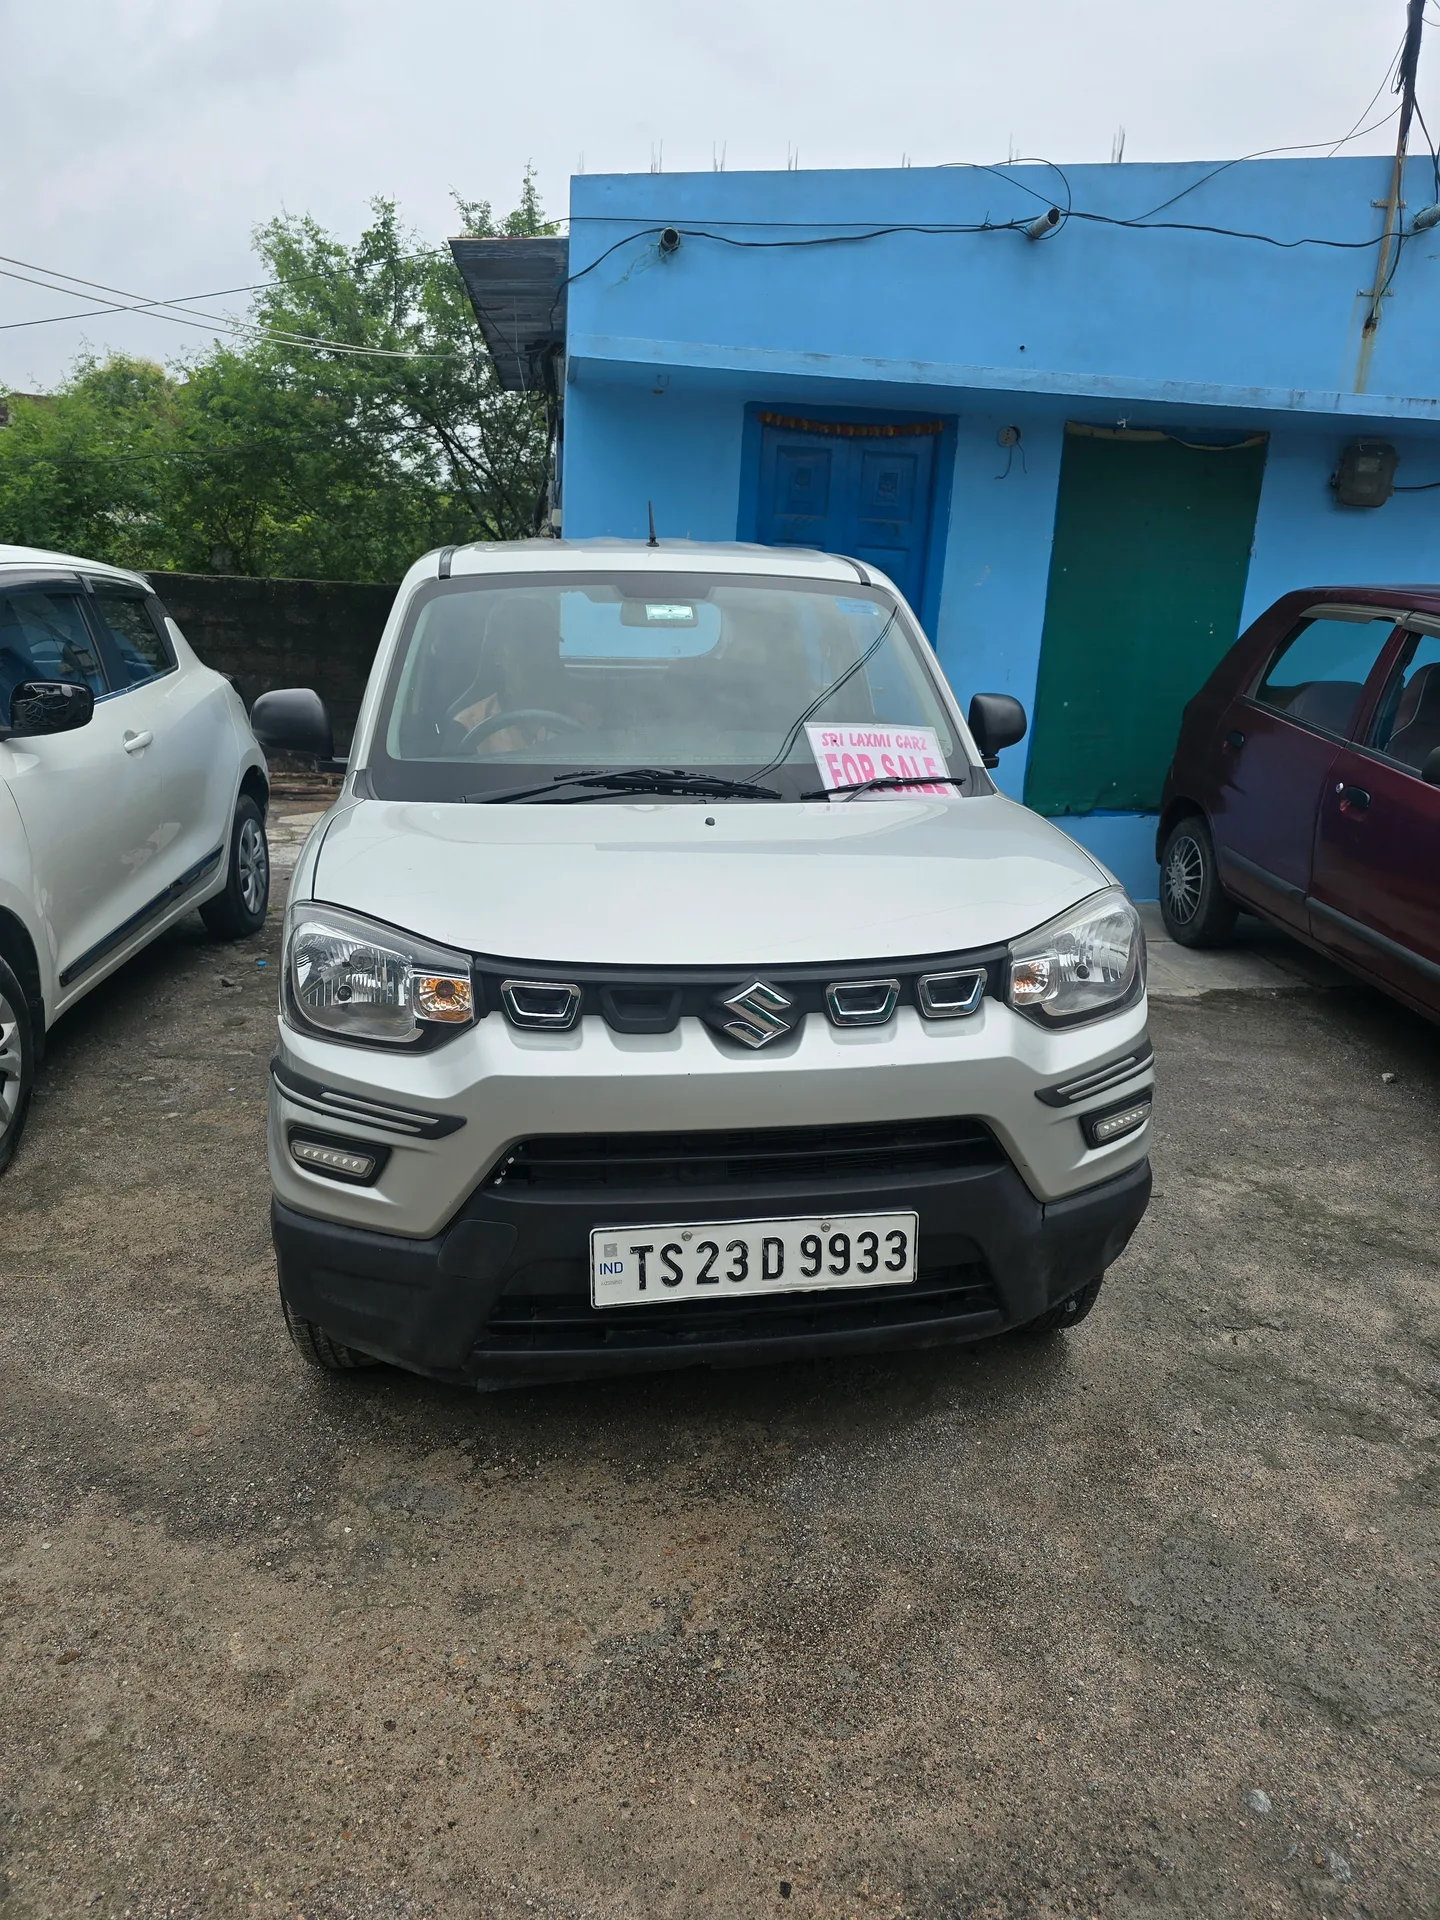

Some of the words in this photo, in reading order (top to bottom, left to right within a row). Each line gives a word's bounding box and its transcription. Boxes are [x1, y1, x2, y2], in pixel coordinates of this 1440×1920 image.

[821, 732, 843, 748] SRI
[849, 732, 891, 748] LAXMI
[824, 752, 884, 793] FOR
[880, 753, 949, 795] SALE
[800, 1229, 908, 1278] 9933
[599, 1261, 624, 1276] IND
